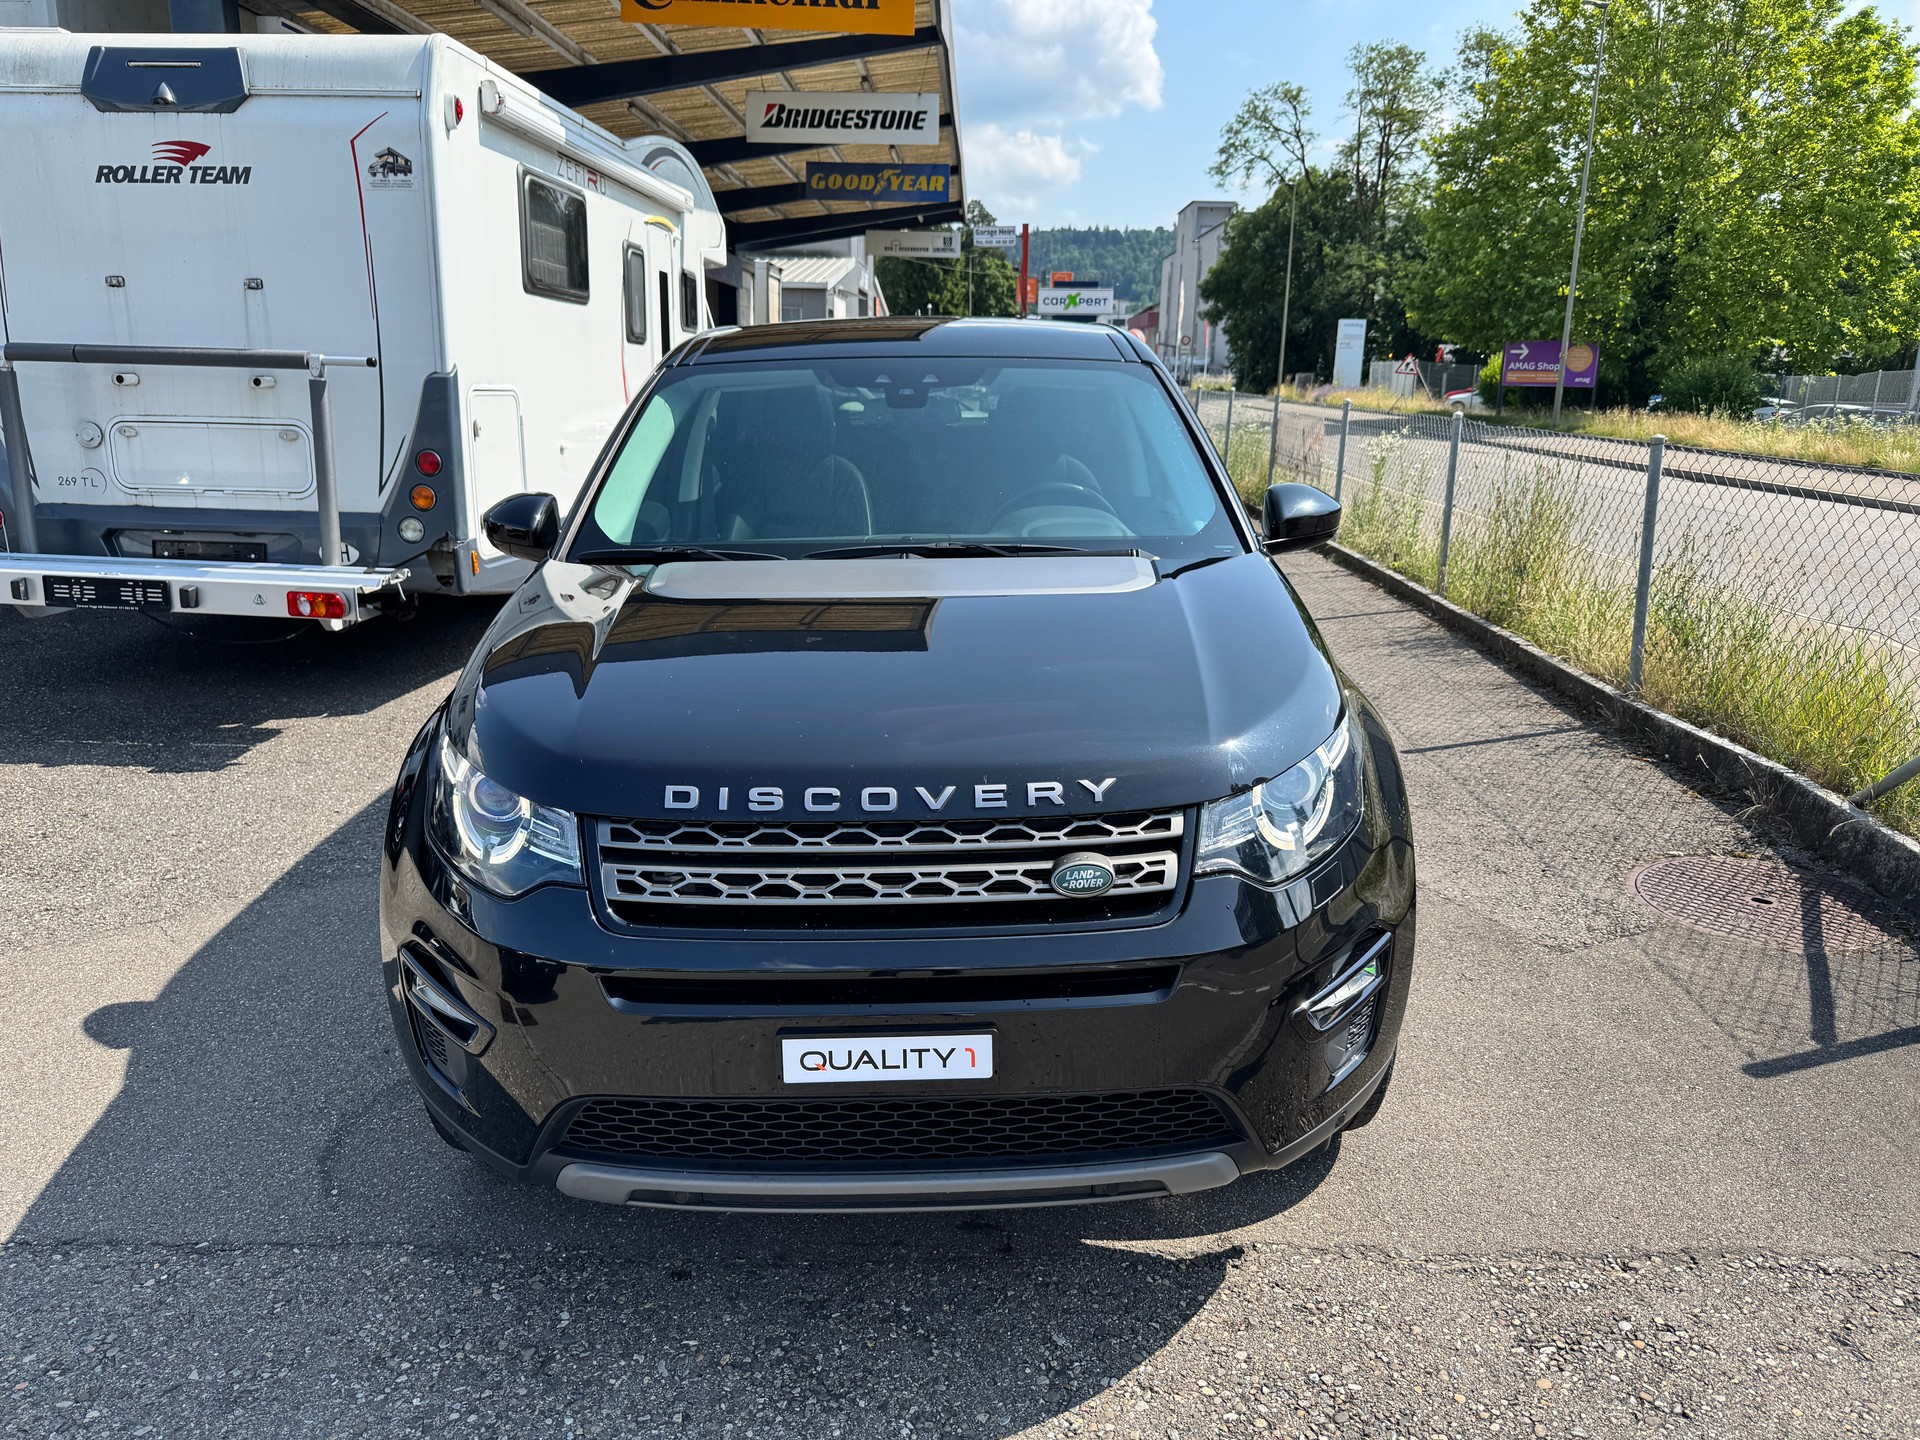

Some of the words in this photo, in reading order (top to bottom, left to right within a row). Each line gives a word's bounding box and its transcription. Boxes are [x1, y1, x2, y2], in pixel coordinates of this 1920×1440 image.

[761, 103, 927, 130] BRIDGESTONE
[95, 165, 183, 184] ROLLER
[189, 166, 252, 184] TEAM
[1508, 361, 1535, 370] AMAG
[1537, 361, 1560, 371] Shop
[58, 475, 77, 486] 269
[81, 477, 99, 487] TL
[664, 777, 1118, 812] DISCOVERY
[1066, 869, 1094, 880] LAND
[1068, 878, 1104, 889] ROVER
[800, 1048, 957, 1071] QUALITY
[964, 1047, 976, 1068] 1
